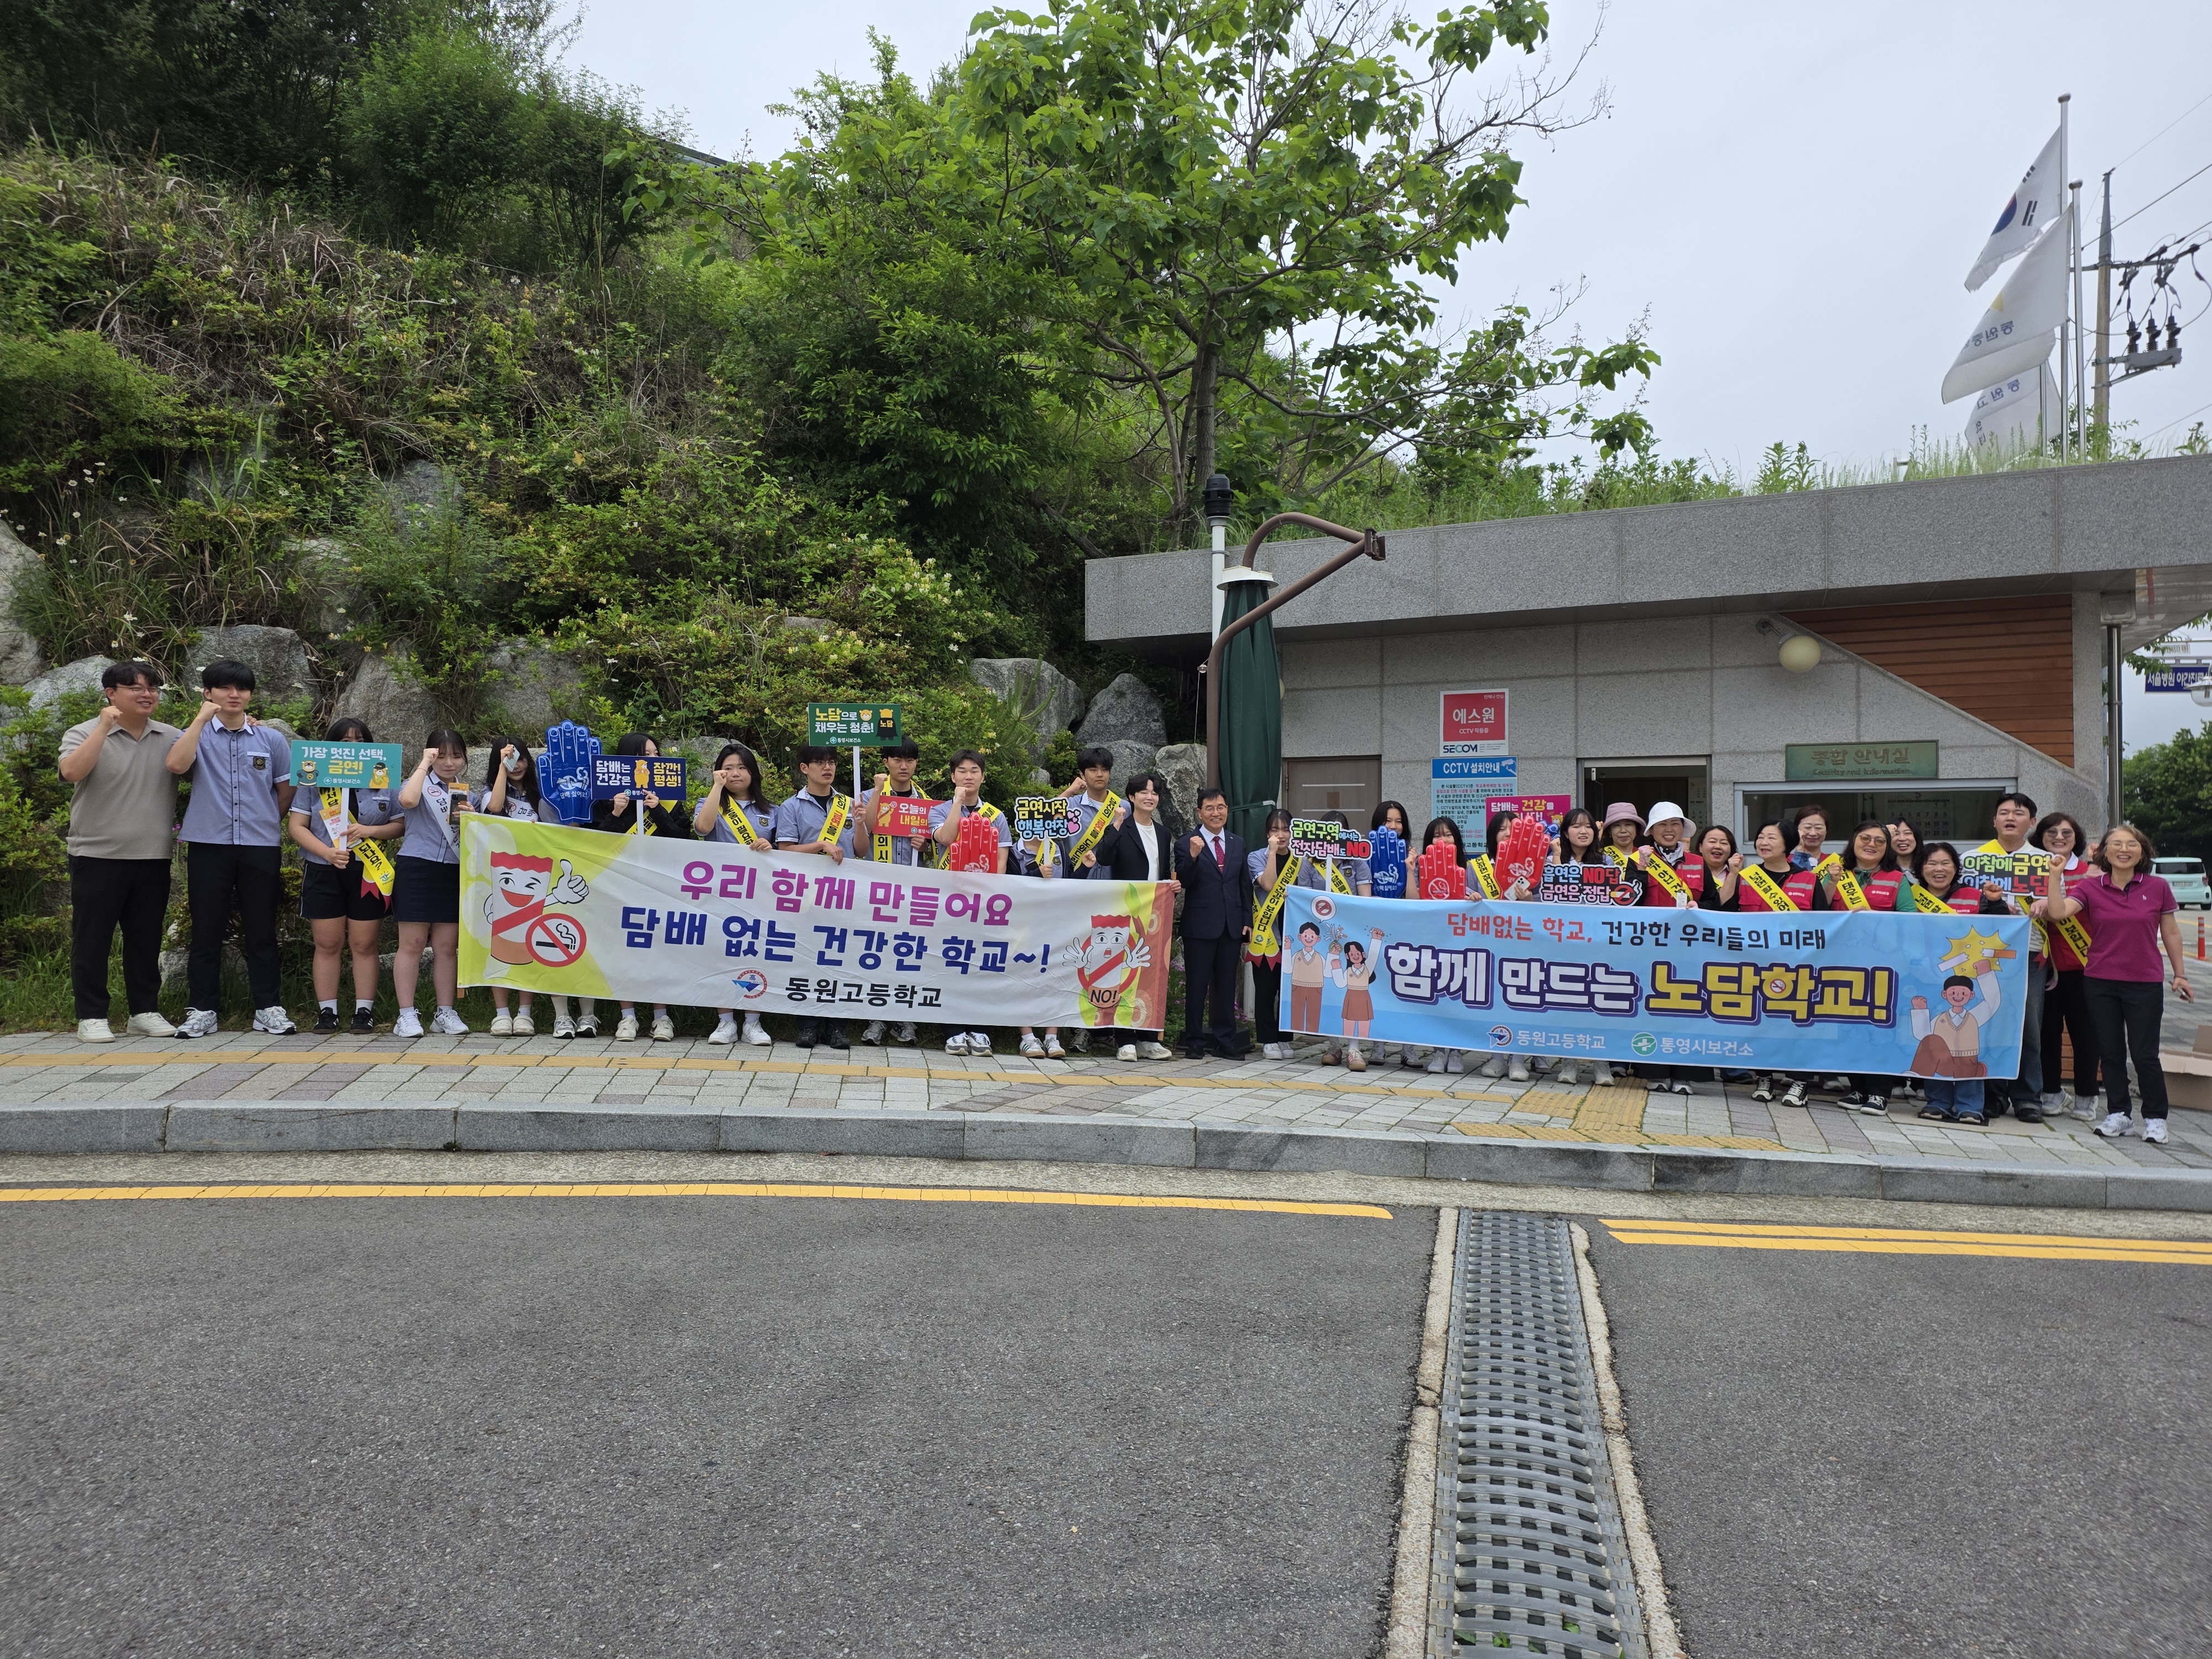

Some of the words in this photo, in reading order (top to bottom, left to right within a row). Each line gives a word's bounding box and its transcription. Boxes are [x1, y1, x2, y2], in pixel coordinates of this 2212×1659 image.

[2177, 672, 2206, 687] 야간진
[815, 708, 858, 721] 노담으로
[1453, 707, 1495, 724] 에스원
[815, 722, 848, 733] 채우는
[850, 722, 874, 733] 청춘!
[301, 747, 328, 759] 가장
[330, 747, 355, 760] 멋진
[358, 748, 387, 761] 선택,
[1443, 744, 1478, 753] SECOM
[1812, 749, 1849, 766] 종합
[1854, 747, 1911, 765] 안내실
[328, 760, 364, 775] 금연!
[596, 760, 632, 773] 담배는
[653, 762, 681, 774] 잠깐!
[1443, 763, 1470, 774] CCTV
[1470, 761, 1500, 774] 설치안내
[1812, 769, 1845, 777] Security
[596, 774, 632, 786] 건강은
[653, 775, 682, 787] 평생!
[837, 794, 848, 811] 신의
[898, 803, 926, 815] 오늘의
[1017, 800, 1067, 819] 금연시작
[1102, 797, 1117, 818] 당신의
[1491, 802, 1519, 812] 담배는
[1522, 799, 1554, 811] 건강을
[826, 811, 843, 837] 금연을
[900, 815, 928, 827] 내일의
[1018, 819, 1068, 839] 행복연장
[1090, 817, 1107, 839] 금연을
[1292, 821, 1359, 841] 금연구역에서는
[1292, 839, 1347, 857] 전자담배도
[1346, 841, 1370, 858] NO
[1965, 855, 2013, 873] 이참에
[2012, 854, 2049, 876] 금연
[1543, 865, 1582, 884] 흡연은
[1583, 867, 1620, 885] NO답
[1657, 869, 1676, 885] 아닌
[681, 861, 757, 900] 우리
[772, 868, 854, 912] 함께
[869, 881, 1013, 927] 만들어요
[1542, 884, 1580, 902] 금연은
[1581, 885, 1611, 902] 정답
[1749, 872, 1768, 889] 너라면
[1773, 896, 1791, 911] 있어
[1841, 880, 1862, 905] 태우는
[2013, 875, 2049, 896] 노담
[1269, 886, 1286, 905] 건강이
[1914, 893, 1936, 910] 너라면
[1257, 905, 1275, 933] 보입니다
[621, 906, 707, 949] 담배
[722, 915, 796, 962] 없는
[813, 925, 928, 972] 건강한
[942, 935, 1050, 975] 학교~!
[1448, 912, 1533, 941] 담배없는
[1542, 917, 1593, 943] 학교,
[1601, 921, 1671, 947] 건강한
[1679, 924, 1769, 952] 우리들의
[1780, 928, 1825, 951] 미래
[785, 977, 942, 1009] 동원고등학교
[1386, 945, 1490, 1003] 함께
[1501, 958, 1636, 1011] 만드는
[1647, 963, 1892, 1022] 노담학교!
[1089, 988, 1118, 1004] NO!
[1516, 1030, 1606, 1050] 동원고등학교
[1660, 1037, 1754, 1057] 통영시보건소
